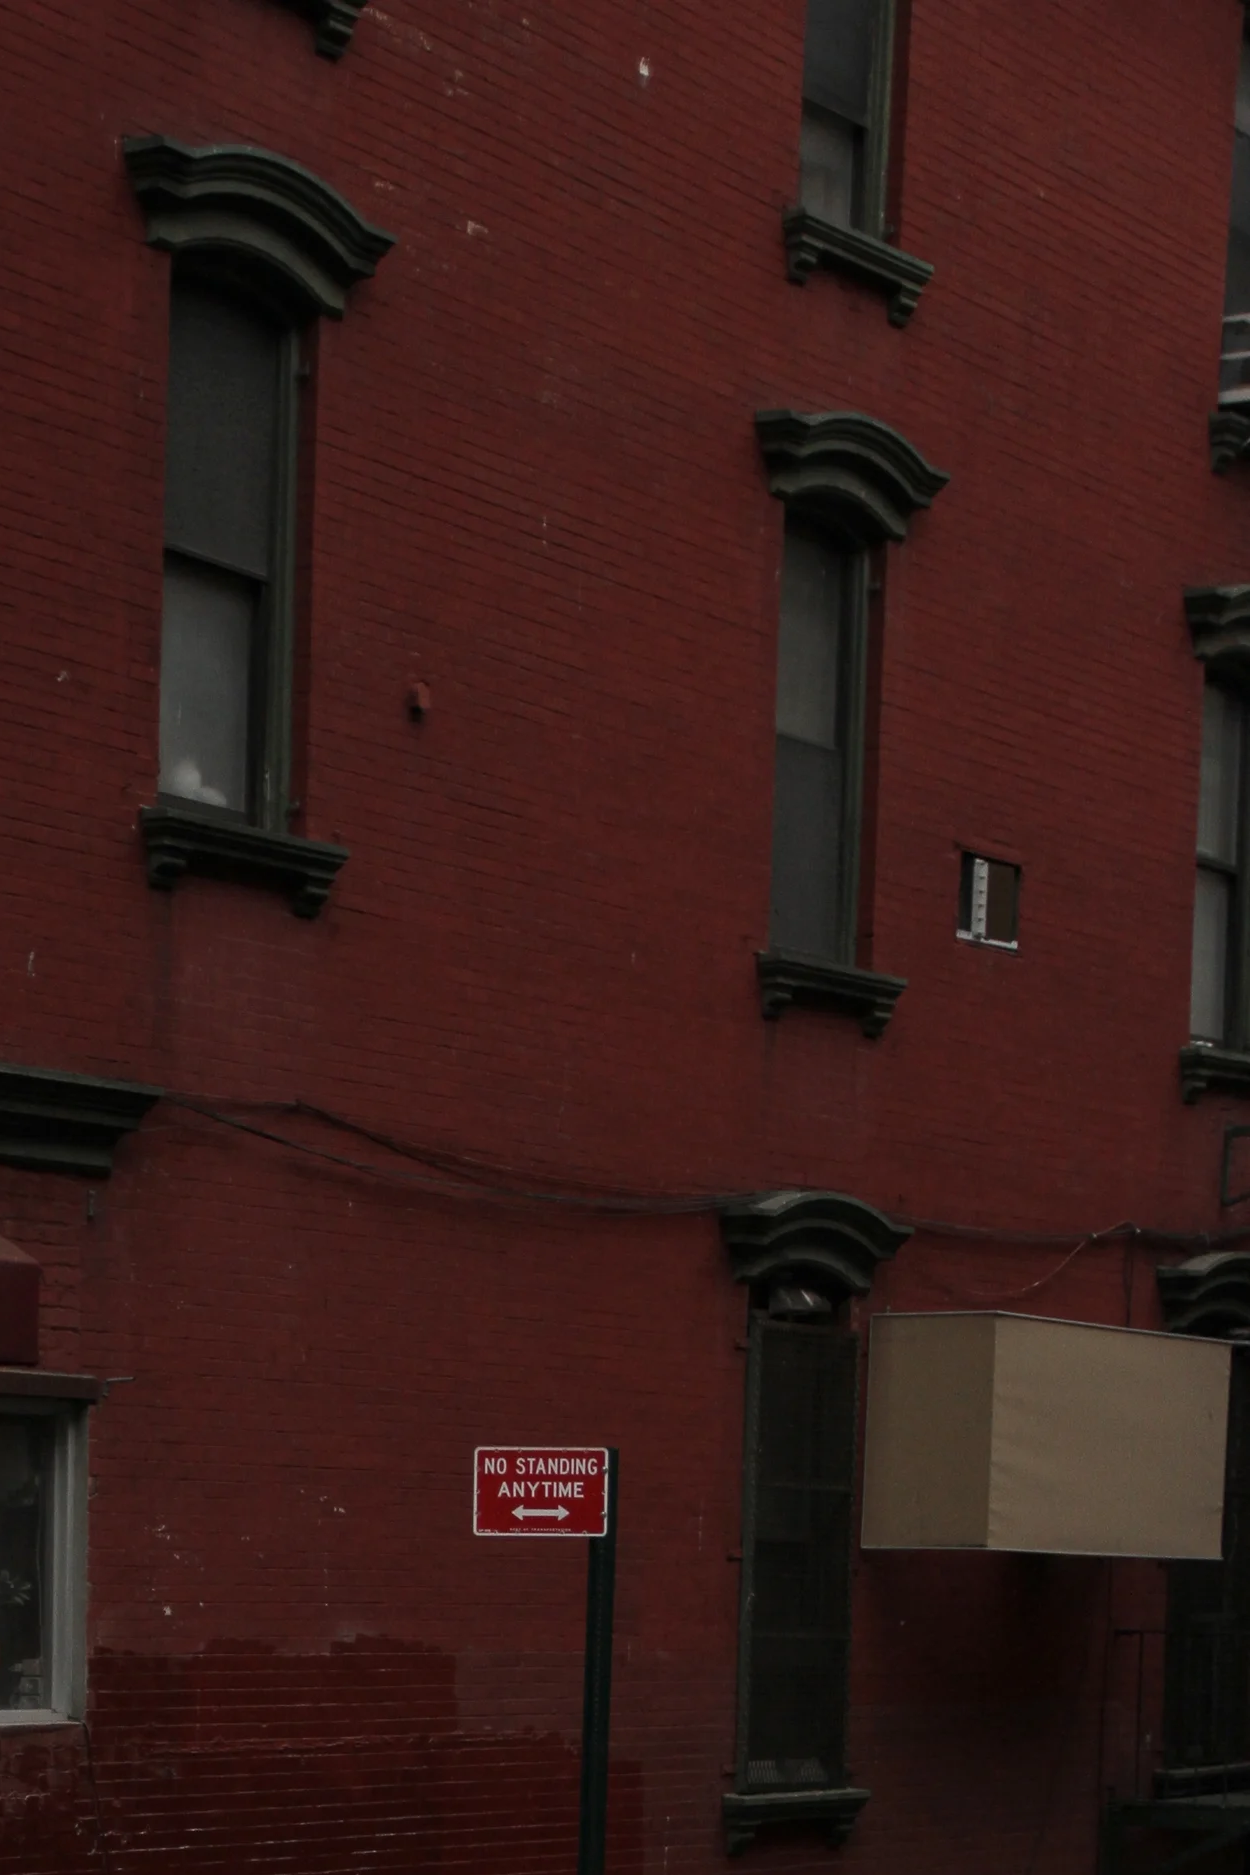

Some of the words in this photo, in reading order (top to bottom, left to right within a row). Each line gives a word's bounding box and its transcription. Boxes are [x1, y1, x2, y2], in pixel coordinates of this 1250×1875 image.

[484, 1457, 508, 1475] NO
[515, 1457, 599, 1475] STANDING
[497, 1481, 585, 1498] ANYTIME
